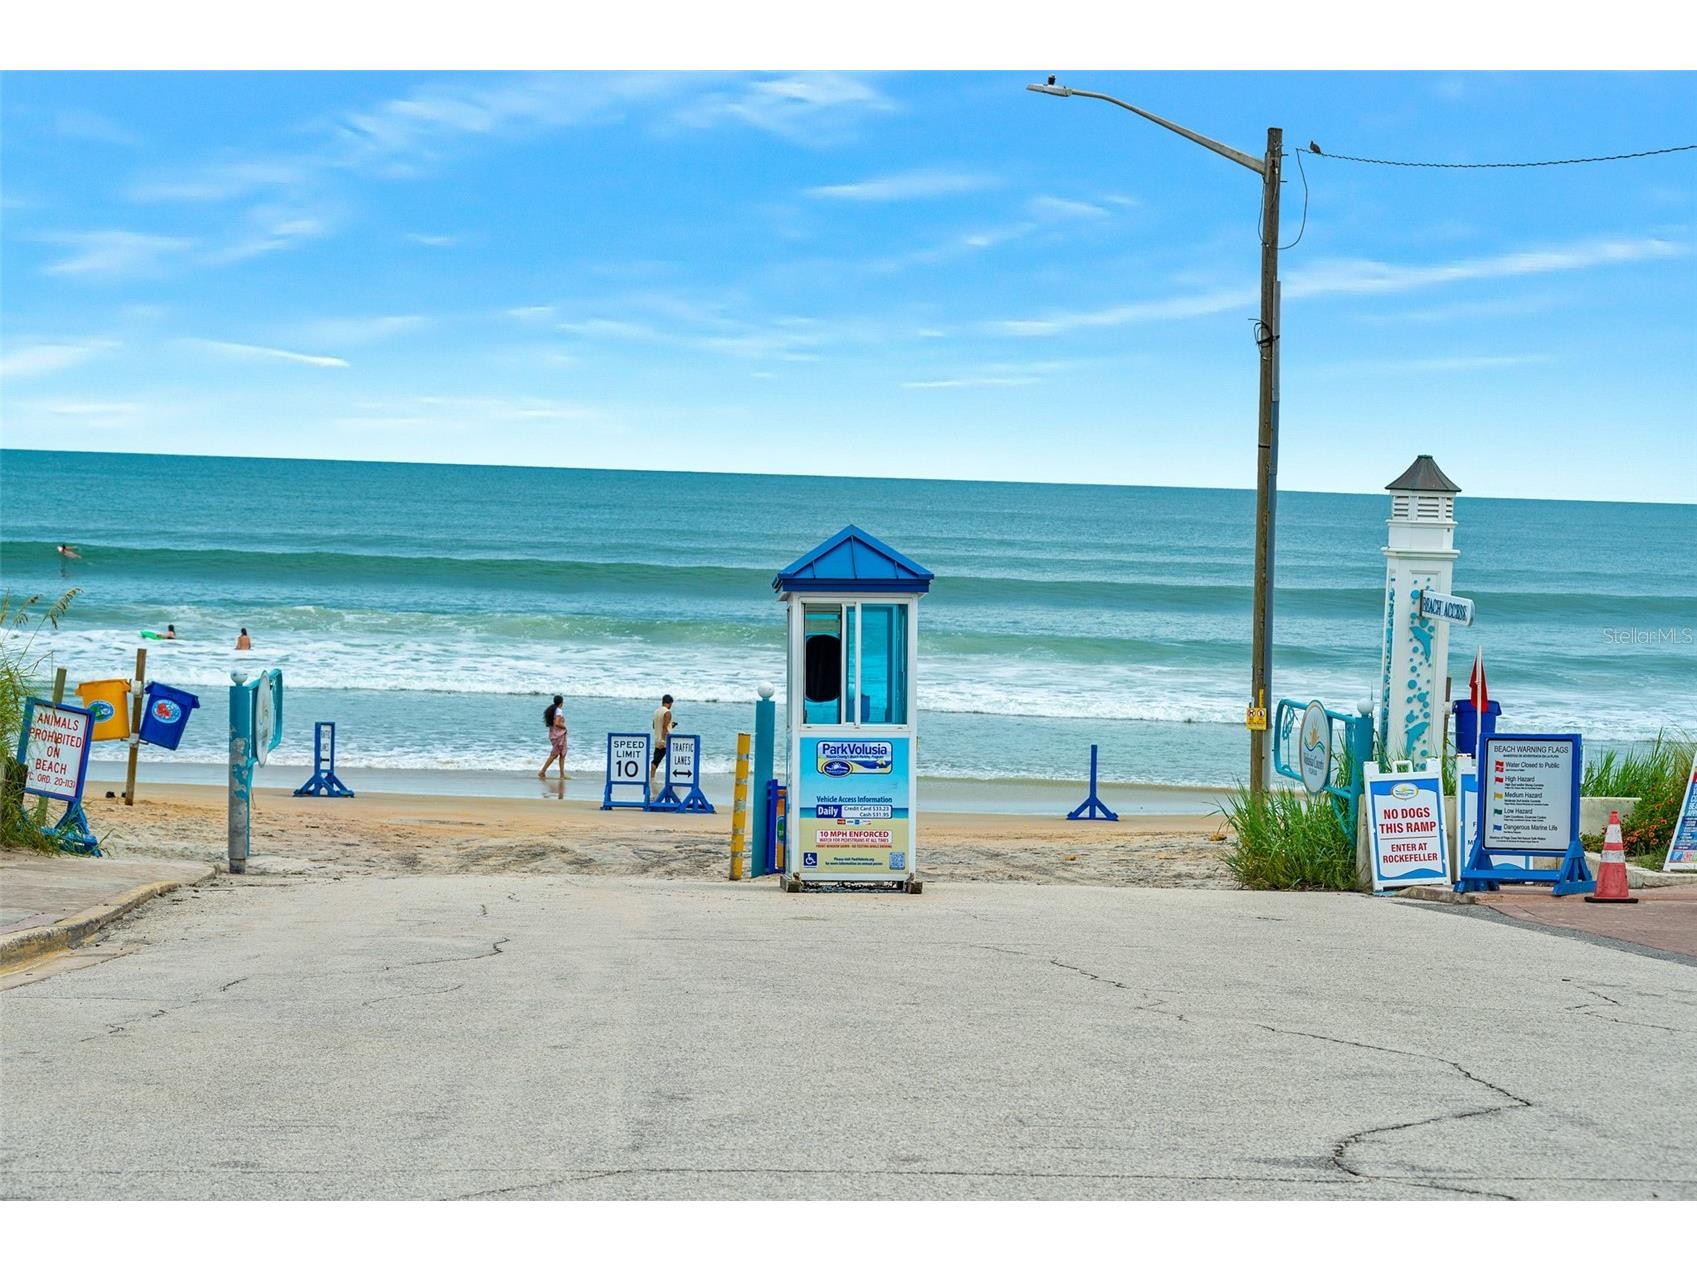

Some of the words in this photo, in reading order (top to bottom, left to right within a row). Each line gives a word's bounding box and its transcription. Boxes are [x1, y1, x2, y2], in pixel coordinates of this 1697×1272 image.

[1424, 597, 1442, 615] BEACH
[1444, 602, 1467, 620] ACCESS
[37, 713, 79, 731] ANIMALS
[29, 728, 82, 748] PROHIBITED
[47, 746, 60, 758] ON
[673, 743, 694, 752] TRAFFIC
[36, 758, 67, 774] BEACH
[675, 756, 691, 765] LANES
[616, 761, 638, 777] 10
[818, 807, 838, 817] Daily
[1384, 809, 1398, 819] NO
[1402, 808, 1430, 818] DOGS
[1379, 823, 1403, 834] THIS
[1407, 822, 1436, 832] RAMP
[1391, 844, 1416, 852] ENTER
[1383, 853, 1438, 863] ROCKEFELLER
